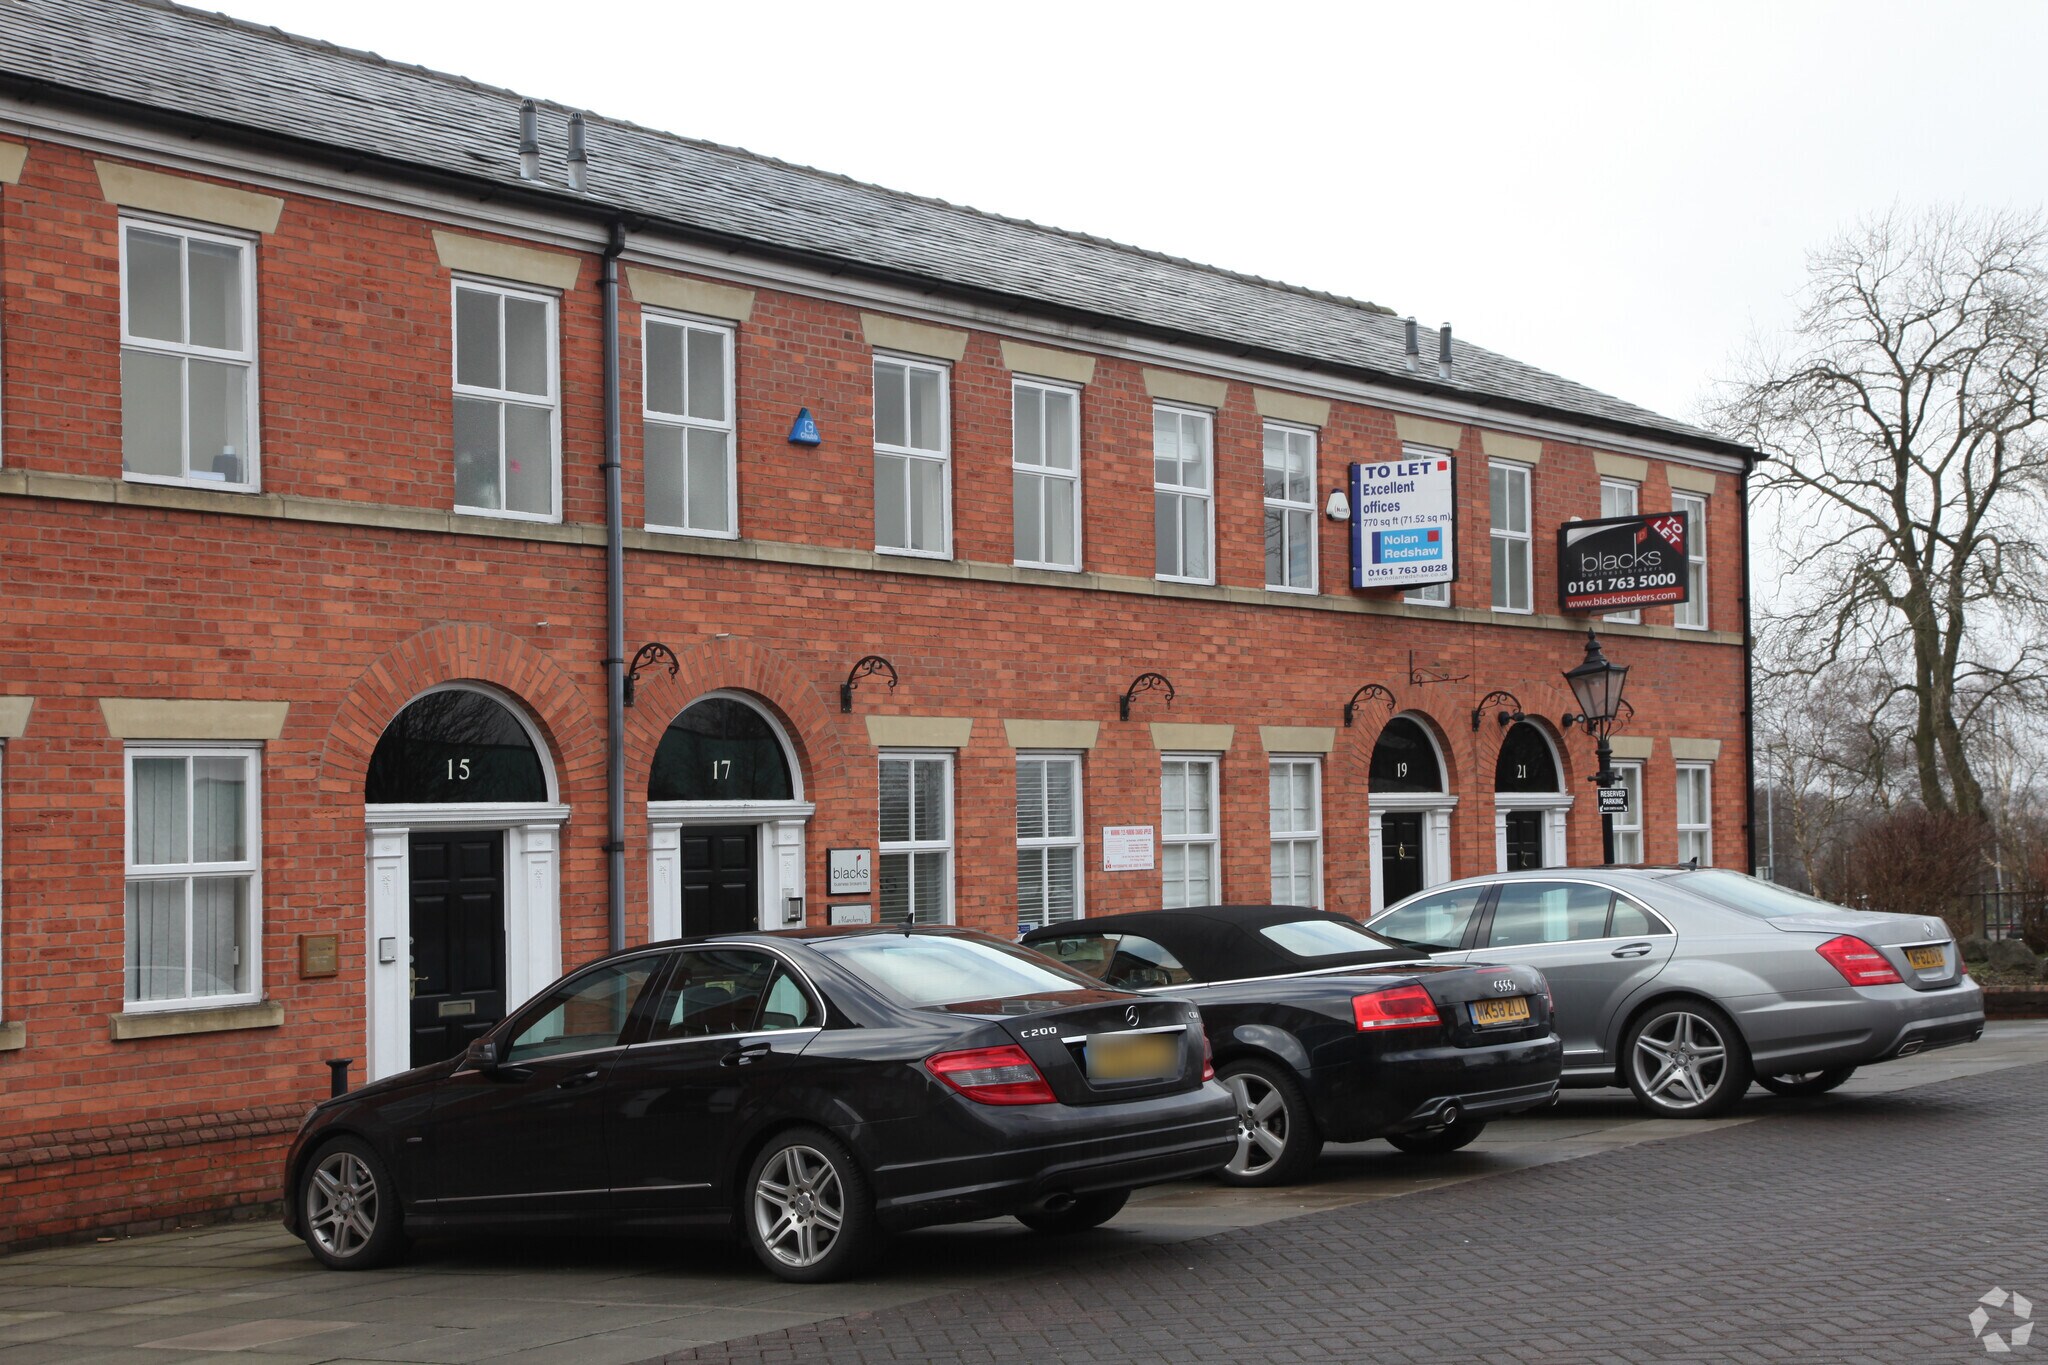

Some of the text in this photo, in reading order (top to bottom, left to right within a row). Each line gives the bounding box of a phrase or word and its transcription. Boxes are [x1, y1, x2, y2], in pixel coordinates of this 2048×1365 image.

[800, 432, 818, 441] Chubb
[1365, 462, 1431, 479] TO LET
[1363, 480, 1415, 496] Excellent
[1363, 500, 1400, 514] offices
[1363, 518, 1378, 527] 770
[1380, 519, 1390, 527] sq
[1392, 517, 1399, 525] ft
[1400, 514, 1425, 526] (71.52
[1427, 515, 1437, 523] sq
[1666, 516, 1683, 533] TO
[1384, 534, 1419, 545] Nolan
[1652, 520, 1680, 545] LET
[1384, 547, 1439, 559] Redshaw
[1581, 533, 1662, 572] blacks
[1368, 564, 1448, 577] 0161 763 0828
[1368, 572, 1448, 582] www.nolanredshaw.co.uk
[1582, 566, 1662, 578] business brokers
[1567, 572, 1676, 593] 0161 763 5000
[1568, 591, 1677, 608] www.blacksbrokers.com
[447, 758, 471, 780] 15
[713, 760, 731, 780] 17
[1397, 762, 1408, 778] 19
[1517, 764, 1527, 779] 21
[833, 857, 869, 879] blacks
[1476, 1000, 1505, 1021] MK58
